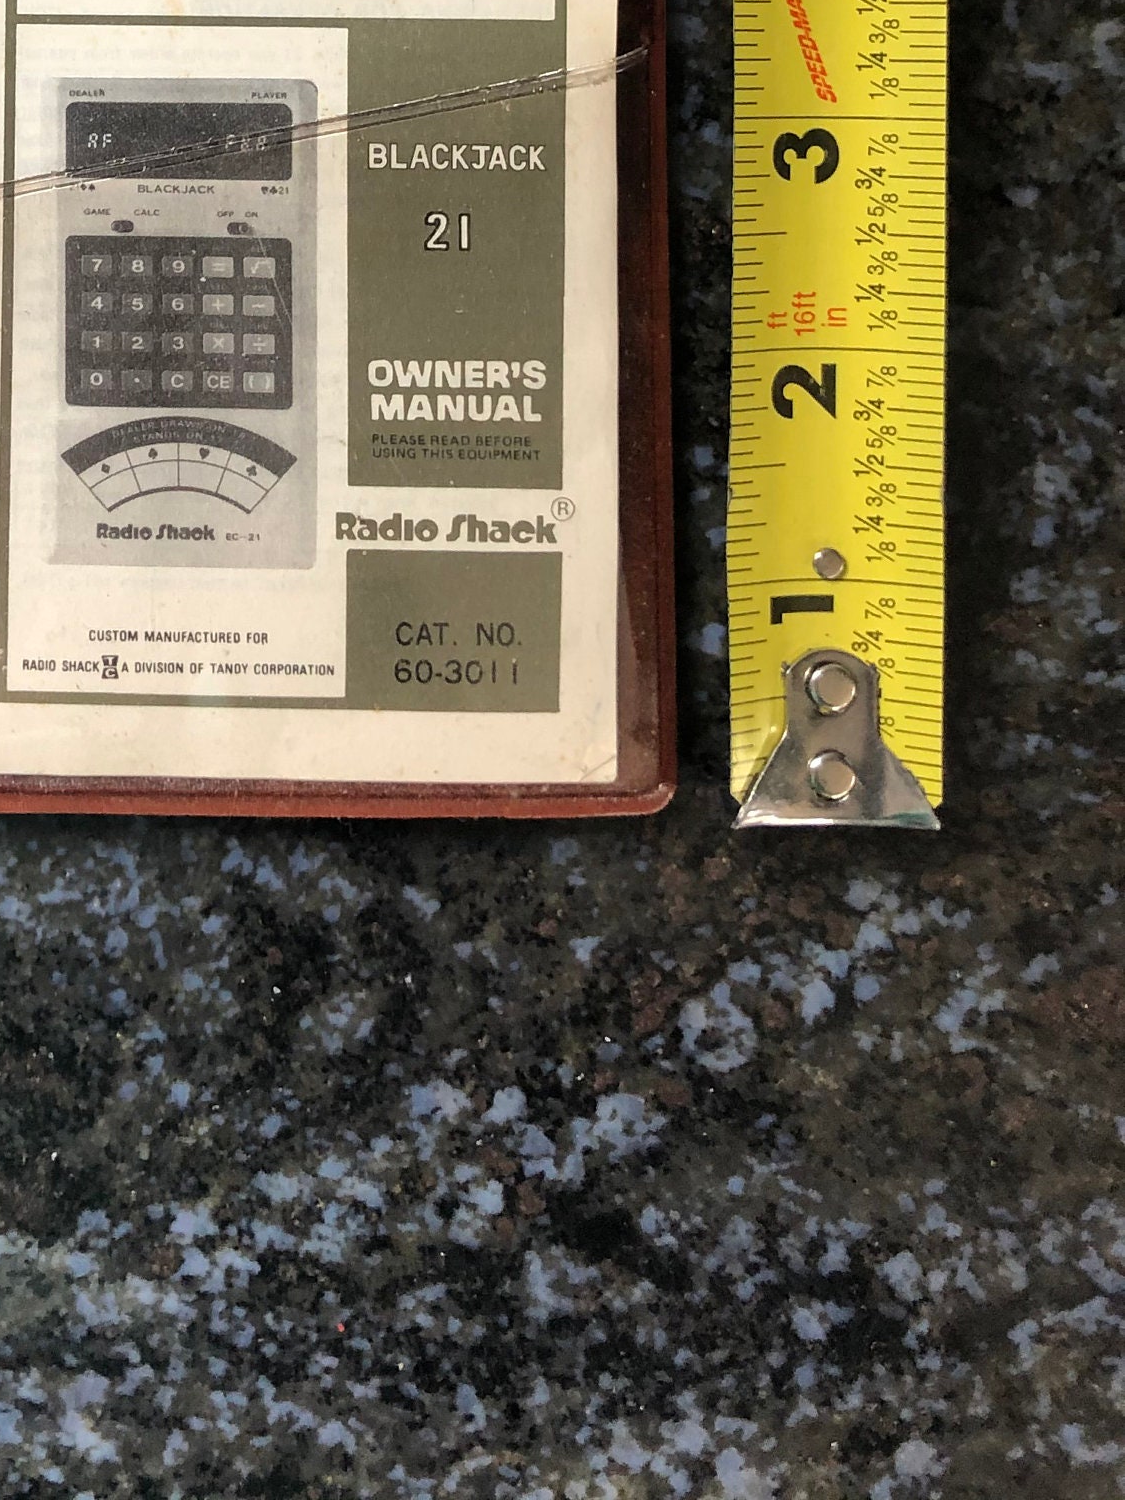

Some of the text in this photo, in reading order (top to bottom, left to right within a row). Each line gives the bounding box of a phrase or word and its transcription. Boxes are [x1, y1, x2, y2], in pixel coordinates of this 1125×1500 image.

[69, 88, 105, 97] DEALER
[369, 143, 545, 170] BLACKJACK
[771, 127, 840, 185] 3
[137, 184, 215, 194] BLACKJACK
[278, 186, 289, 195] 21
[83, 208, 111, 216] GAME
[423, 211, 471, 251] 21
[92, 259, 103, 272] 7
[132, 259, 144, 273] 8
[172, 260, 185, 273] 9
[91, 296, 103, 310] 4
[132, 297, 144, 311] 5
[172, 298, 184, 311] 6
[766, 307, 786, 329] ft
[794, 290, 817, 338] 16ft
[822, 306, 848, 329] in
[93, 336, 100, 348] 1
[132, 336, 144, 349] 2
[173, 336, 184, 351] 3
[171, 374, 184, 388] C
[368, 359, 546, 389] OWNER'S
[207, 375, 232, 389] CE
[771, 362, 837, 420] 2
[371, 394, 542, 422] MANUAL
[372, 433, 531, 447] PLEASE READ BEFORE
[372, 447, 540, 461] USING THIS EQUIPMENT
[96, 523, 152, 541] Radio
[155, 524, 215, 541] Shack
[336, 512, 557, 543] Radio Shack
[770, 595, 834, 625] 1
[89, 630, 268, 645] CUSTOM MANUFACTURED FOR
[395, 621, 522, 647] CAT. NO.
[22, 659, 335, 676] RADIO SHACK A DIVISION OF TANDY CORPORATION
[394, 658, 517, 684] 60-3011
